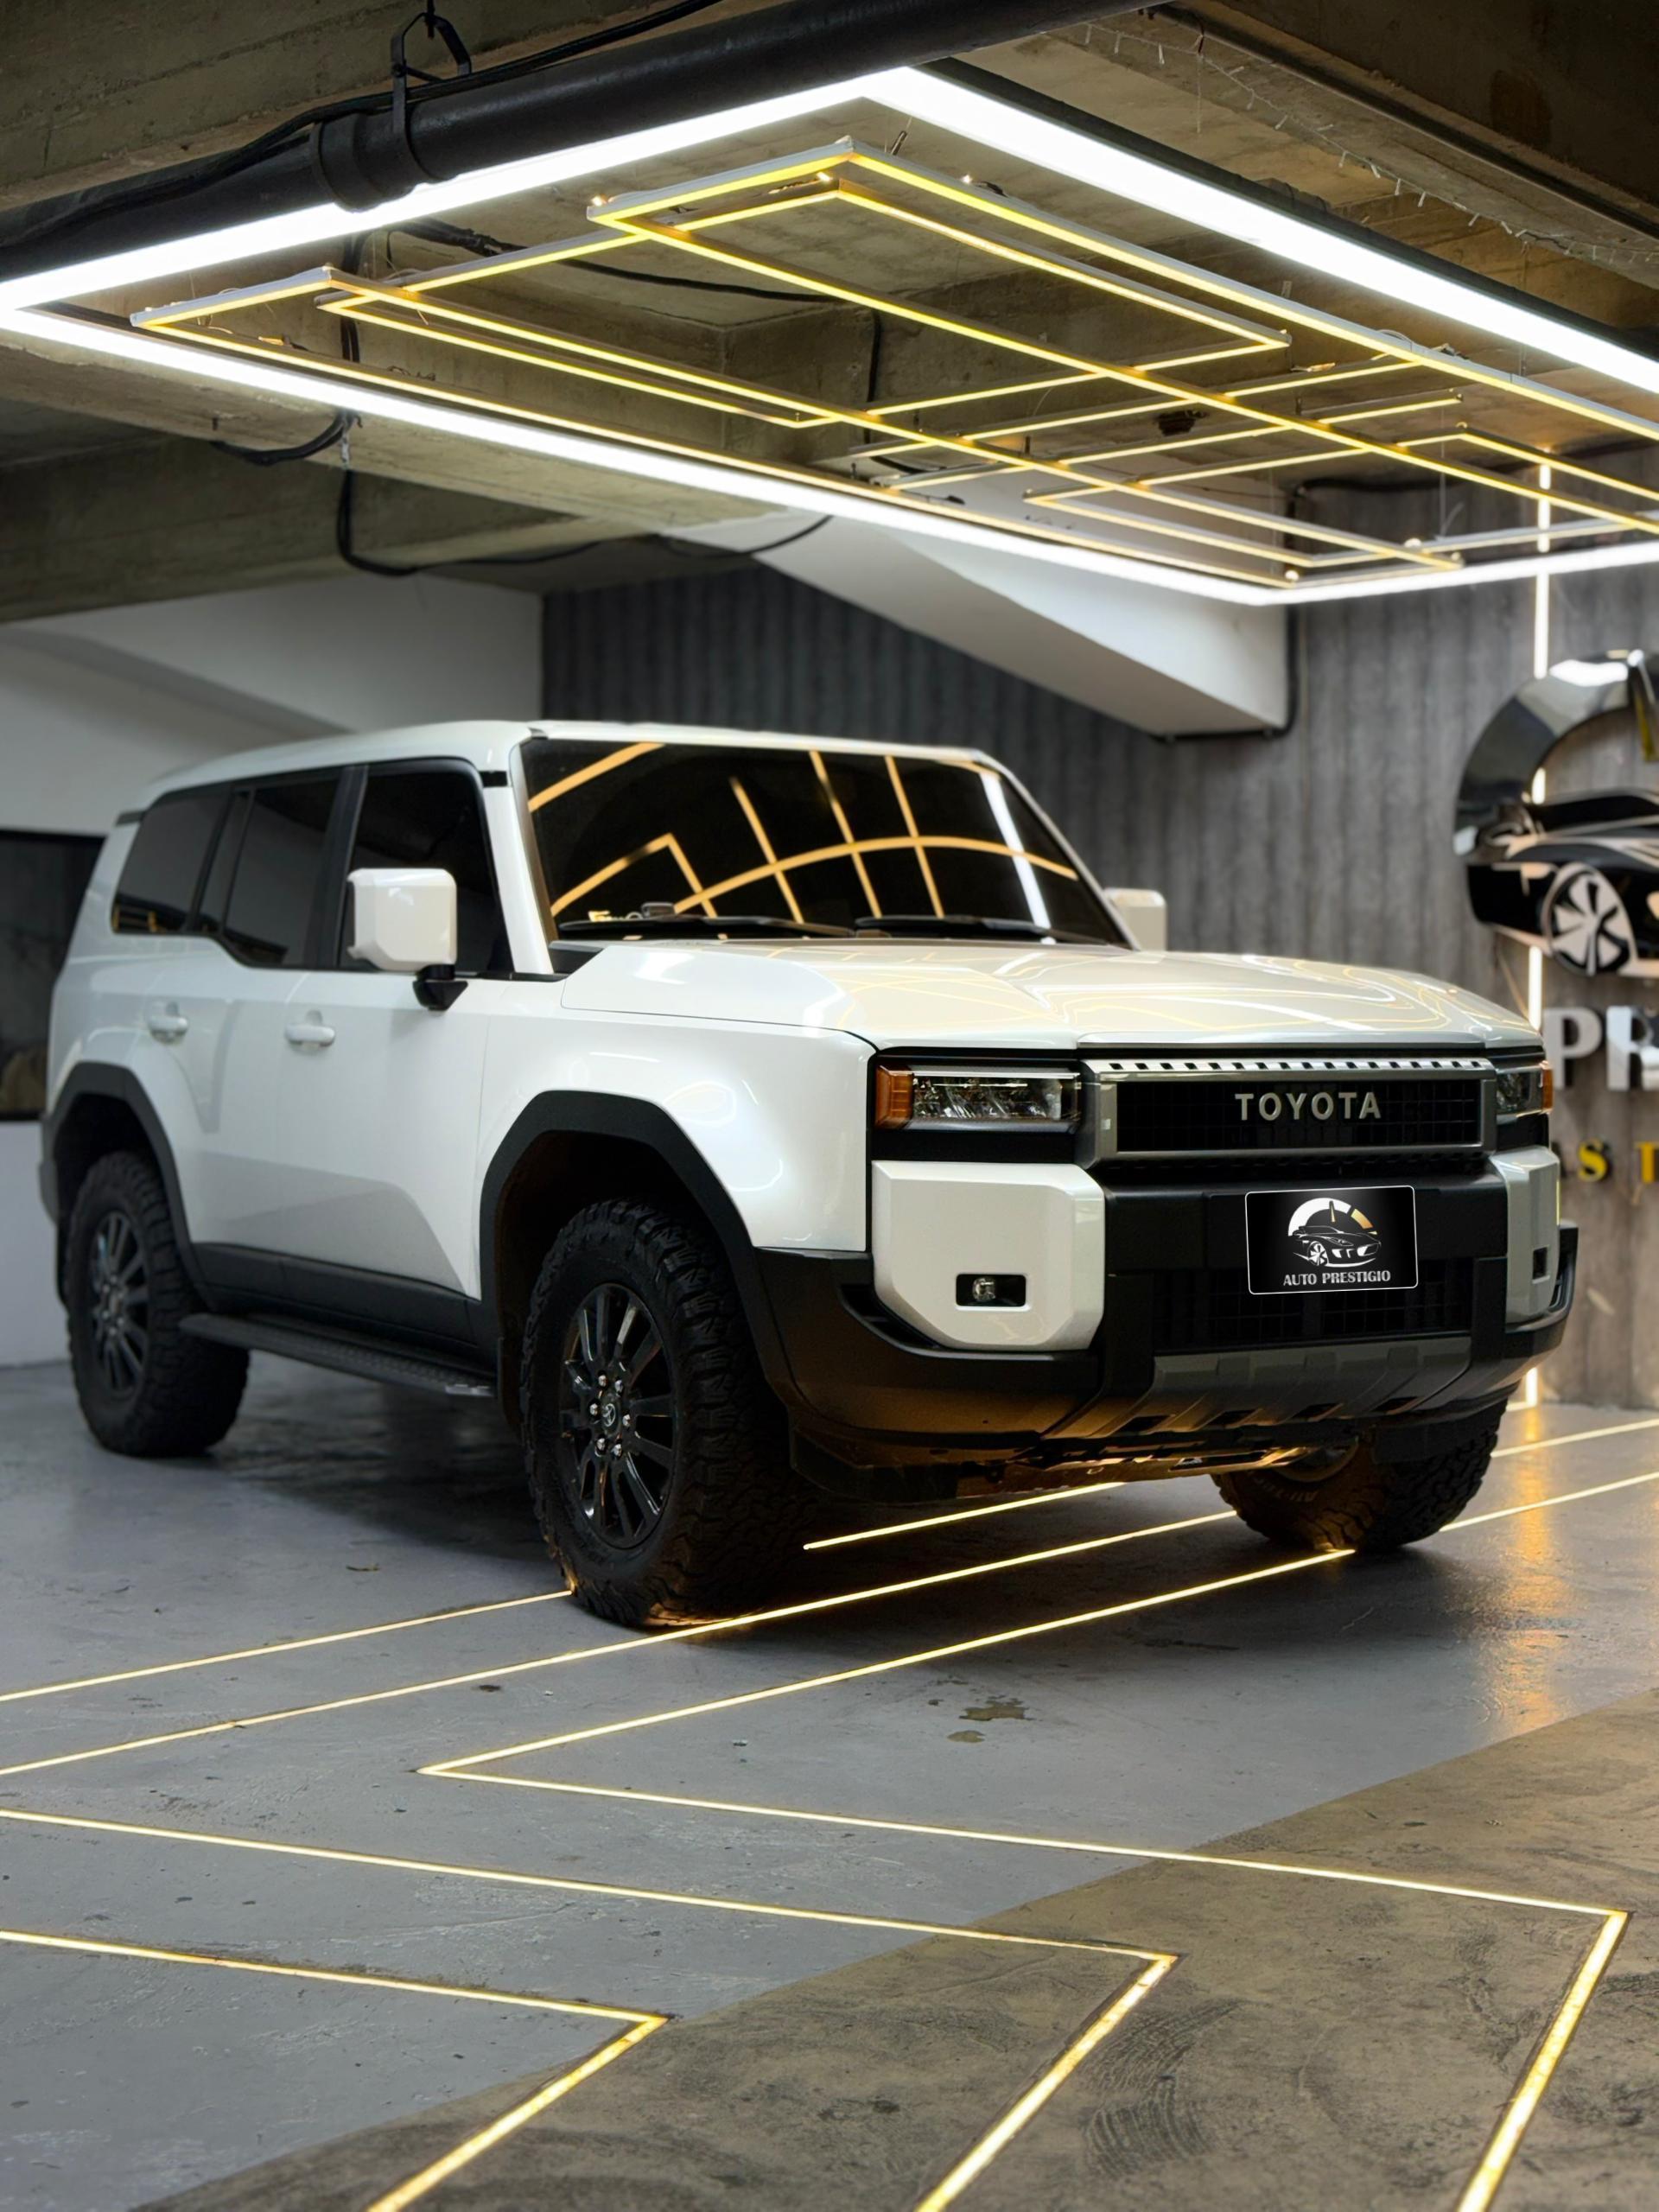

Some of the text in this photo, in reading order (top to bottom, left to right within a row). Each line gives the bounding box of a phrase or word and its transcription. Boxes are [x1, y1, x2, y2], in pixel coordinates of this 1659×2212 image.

[1235, 1091, 1382, 1121] TOYOTA
[1283, 1270, 1391, 1286] AUTO PRESTIGIO
